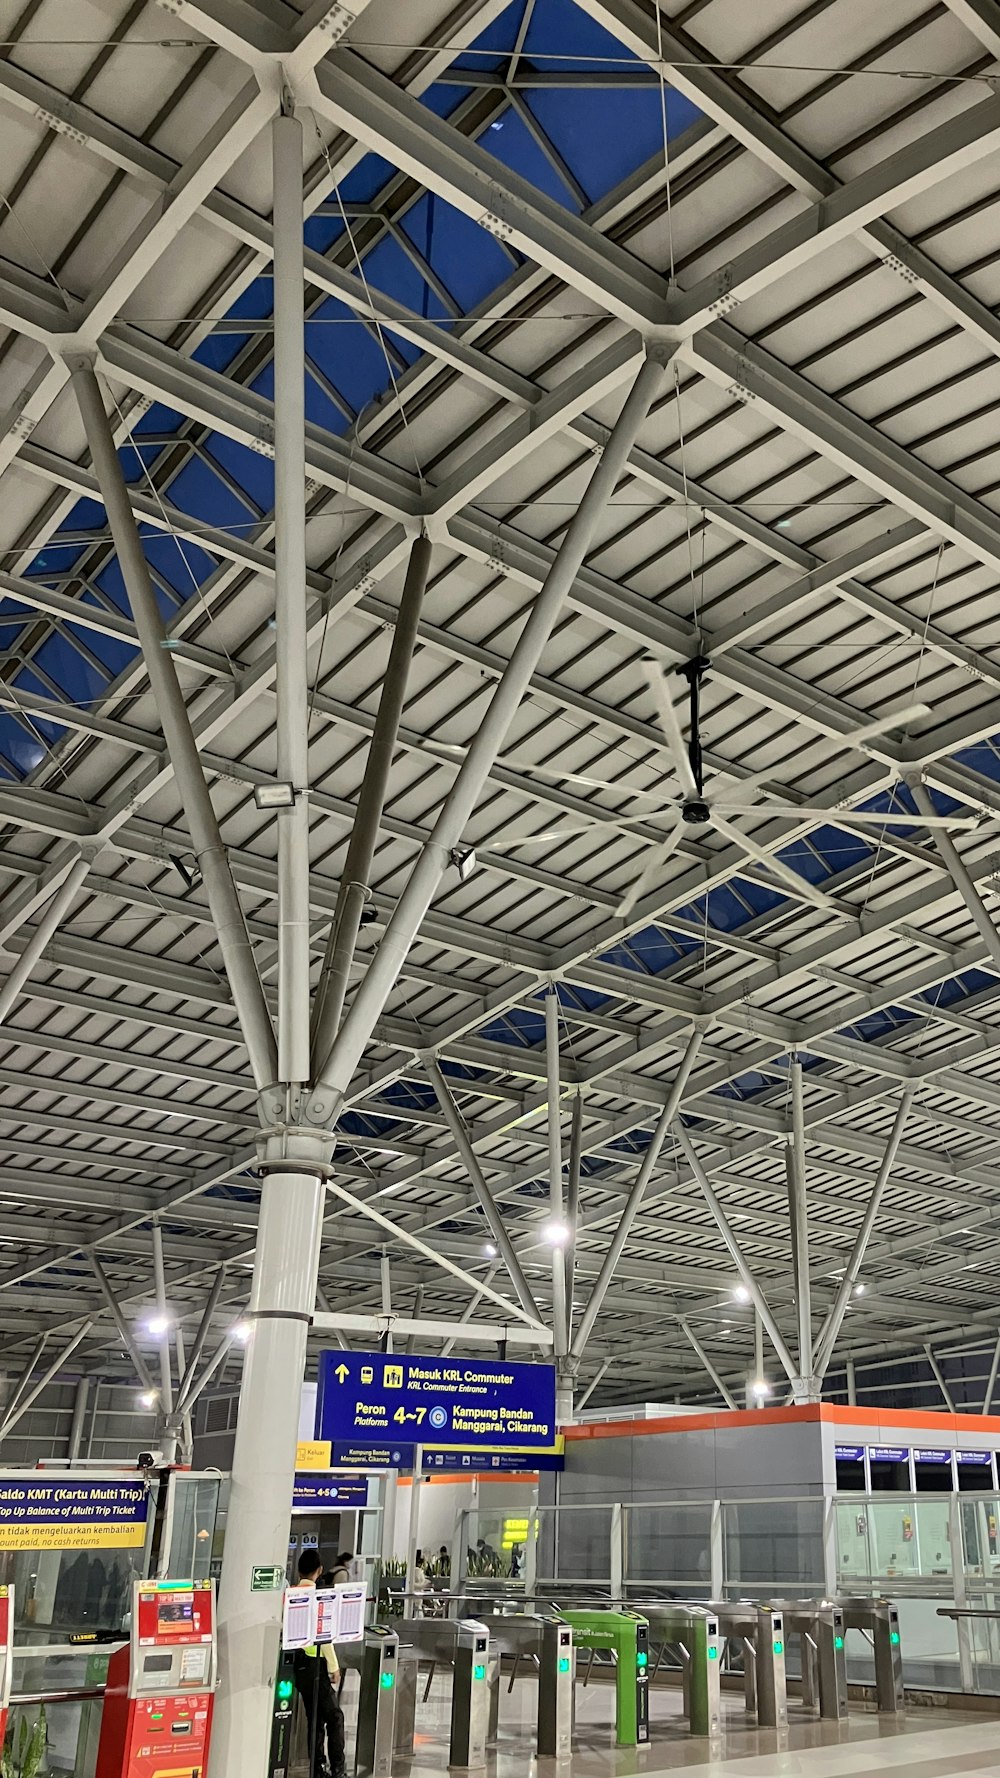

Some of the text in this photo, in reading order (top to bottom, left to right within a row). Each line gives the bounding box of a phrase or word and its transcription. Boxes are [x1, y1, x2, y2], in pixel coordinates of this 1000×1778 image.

[408, 1367, 514, 1384] Masuk KRL Commuter
[407, 1381, 487, 1393] KRL Commuter Entrance
[356, 1402, 427, 1425] Peron 4~7
[452, 1405, 534, 1420] Kampung Bandan
[354, 1416, 388, 1427] Platforms
[452, 1418, 548, 1435] Manggarai, Cikarang
[349, 1449, 372, 1457] Kampung
[368, 1456, 390, 1464] Cikarang
[27, 1489, 52, 1500] KMT
[54, 1489, 88, 1501] (Kartu
[90, 1489, 118, 1499] Multi
[119, 1489, 142, 1501] Trip)
[13, 1507, 25, 1517] Up
[26, 1507, 60, 1515] Balance
[61, 1506, 72, 1517] of
[72, 1506, 94, 1515] Multi
[95, 1506, 111, 1517] Trip
[112, 1506, 136, 1515] Ticket
[8, 1526, 30, 1535] tidak
[32, 1526, 92, 1536] mengeluarkan
[93, 1525, 135, 1534] kembalian
[20, 1538, 40, 1548] paid,
[53, 1537, 71, 1546] cash
[72, 1537, 100, 1545] returns
